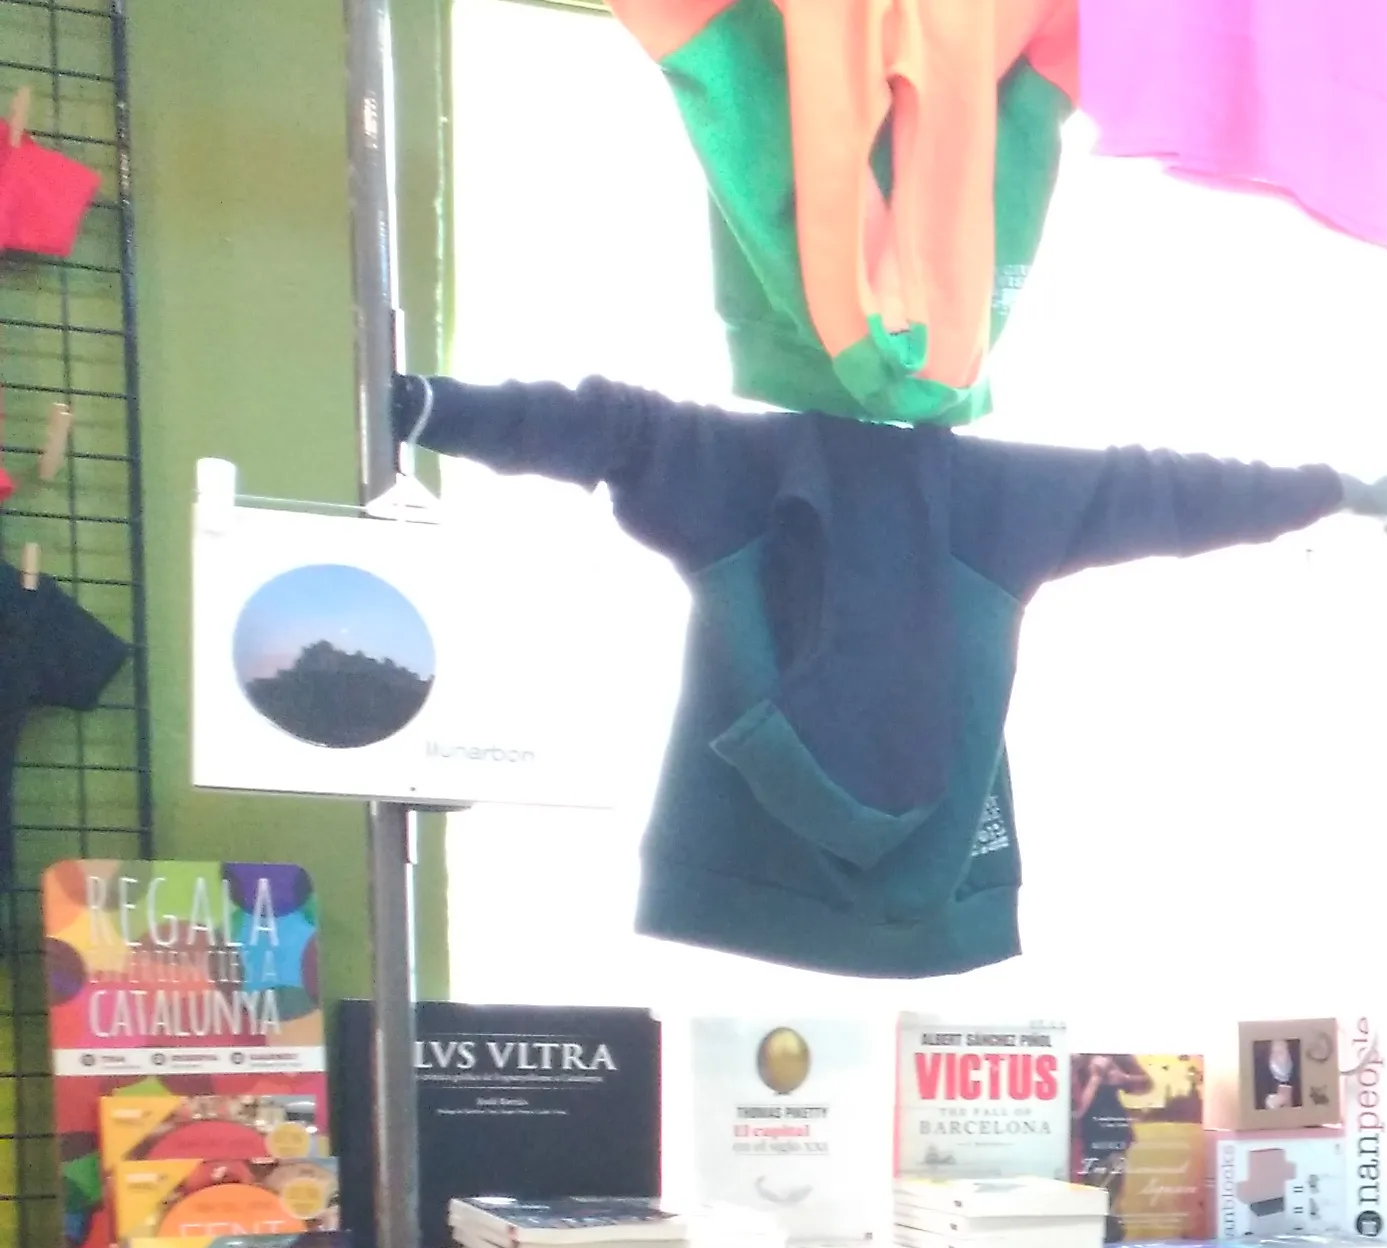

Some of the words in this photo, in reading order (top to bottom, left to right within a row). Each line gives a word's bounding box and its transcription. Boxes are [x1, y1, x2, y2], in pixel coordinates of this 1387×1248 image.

[87, 876, 279, 947] REGALA
[89, 989, 282, 1038] CATALUNYA
[412, 1041, 477, 1070] LVS
[485, 1041, 619, 1071] VLTRA
[914, 1051, 1059, 1101] VICTUS
[919, 1120, 1052, 1136] BARCELONA
